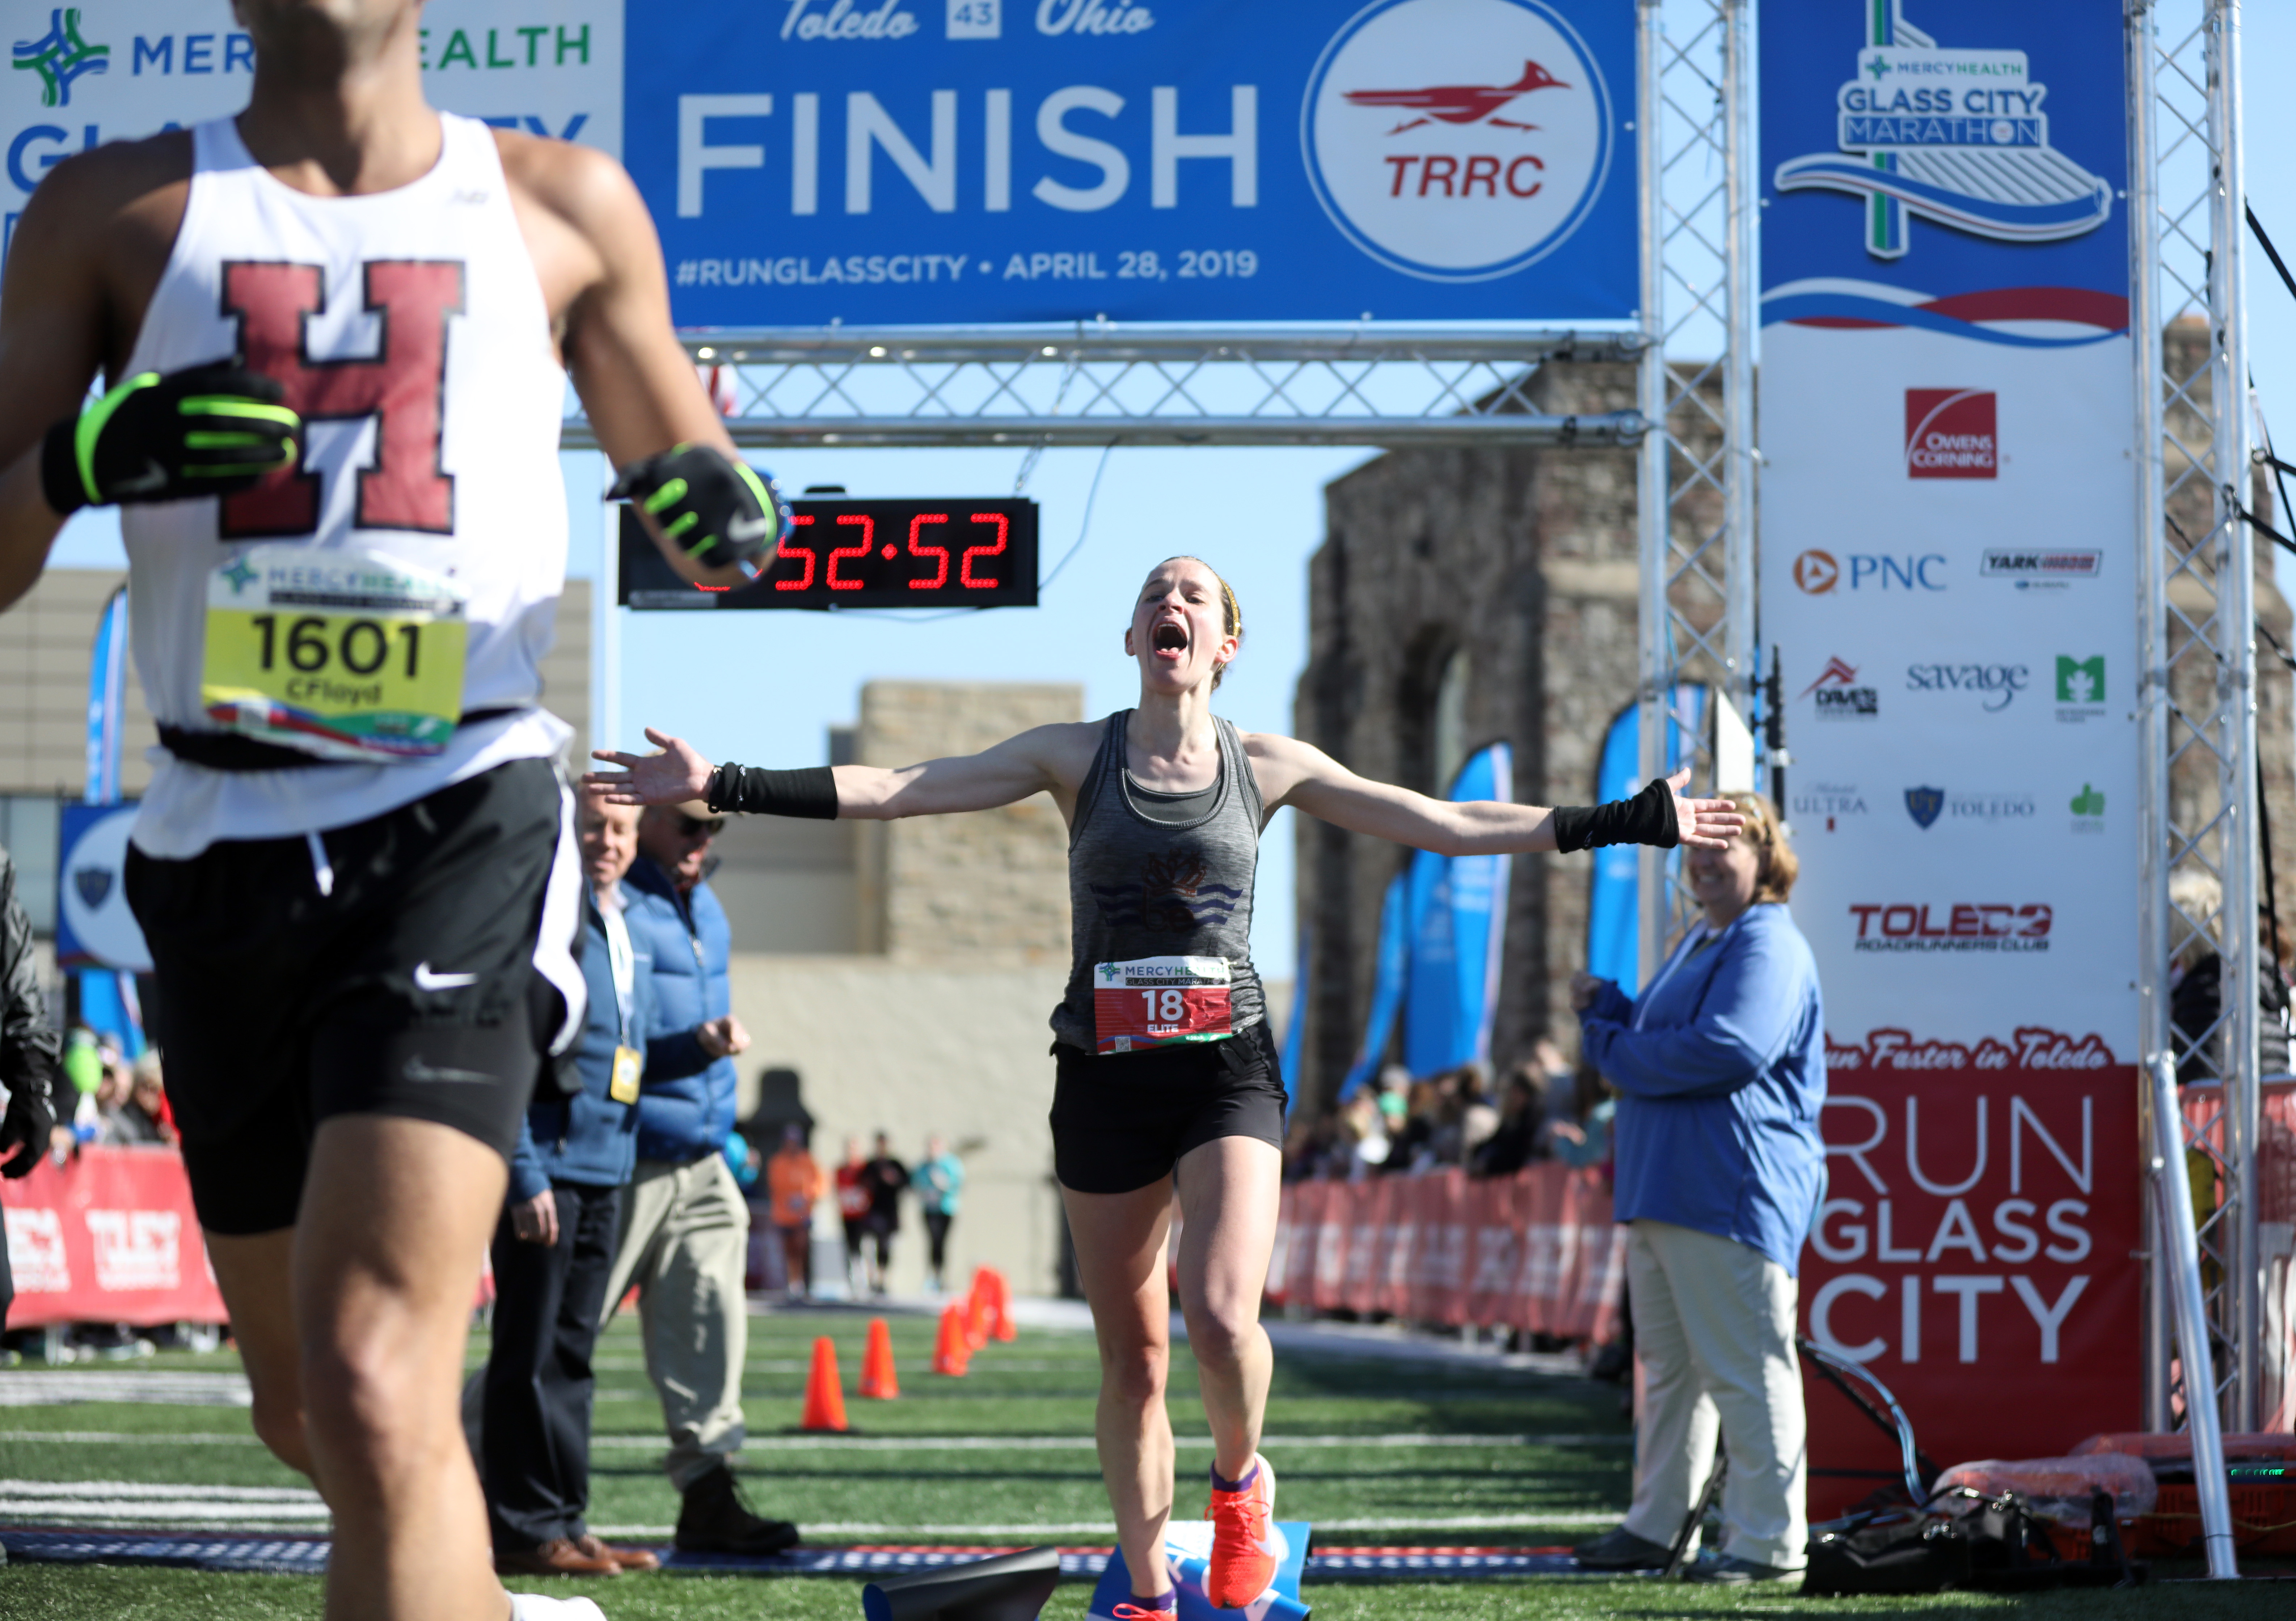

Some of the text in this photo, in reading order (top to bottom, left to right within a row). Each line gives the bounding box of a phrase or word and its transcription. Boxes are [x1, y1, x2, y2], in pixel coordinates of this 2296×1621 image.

[780, 0, 1155, 41] Toledo 43 Ohio
[1897, 62, 2022, 75] MERCYHEALTH
[1844, 88, 2041, 114] GLASS CITY
[1846, 118, 2039, 144] MARATHON
[677, 84, 1258, 218] FINISH
[1384, 155, 1545, 198] TRRC
[675, 249, 1259, 287] #RUNGLASSCITY APRIL 28, 2019
[1926, 432, 1994, 451] OWENS
[1912, 448, 1994, 468] CORNING
[1848, 554, 1946, 591] PNC
[251, 614, 421, 678] 1601
[286, 679, 383, 706] CFloyd
[1906, 663, 2029, 712] savage
[1793, 796, 1868, 813] ULTRA
[1950, 800, 2035, 817] TOLEDO
[1849, 905, 2052, 936] TOLEDO
[1854, 939, 2050, 952] ROADRUNNERS CLUB
[1141, 989, 1184, 1021] 18
[1147, 1024, 1179, 1033] ELITE
[1871, 1035, 1967, 1070] Faster
[1974, 1041, 2009, 1070] in
[2018, 1032, 2109, 1070] Toledo
[1822, 1095, 2093, 1196] RUN
[1810, 1198, 2092, 1264] GLASS
[1810, 1273, 2090, 1364] CITY
